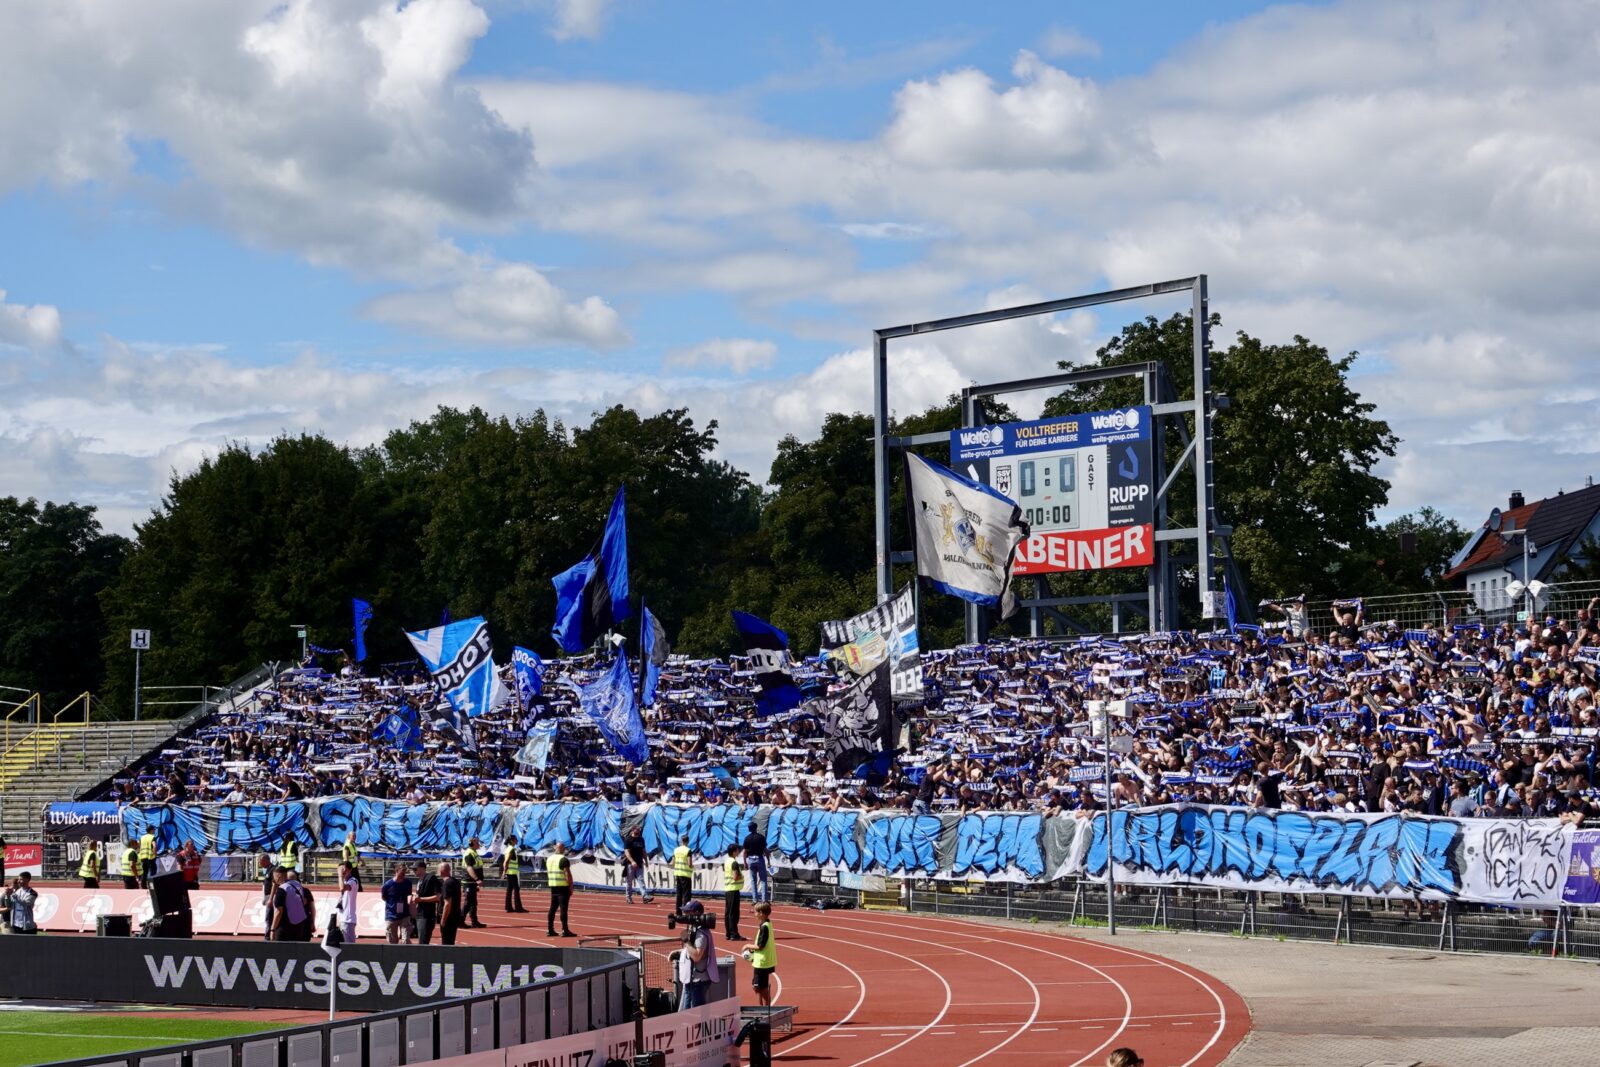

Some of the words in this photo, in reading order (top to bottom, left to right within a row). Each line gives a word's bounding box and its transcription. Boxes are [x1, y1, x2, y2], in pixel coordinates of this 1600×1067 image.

[1016, 421, 1079, 438] VOLLTREFFER
[1015, 438, 1028, 448] FÜR
[1028, 436, 1047, 445] DEINE
[1048, 433, 1079, 444] KARRIERE
[1087, 454, 1095, 491] GAST
[1110, 484, 1149, 504] RUPP
[135, 632, 146, 644] H
[50, 810, 89, 825] Wilder
